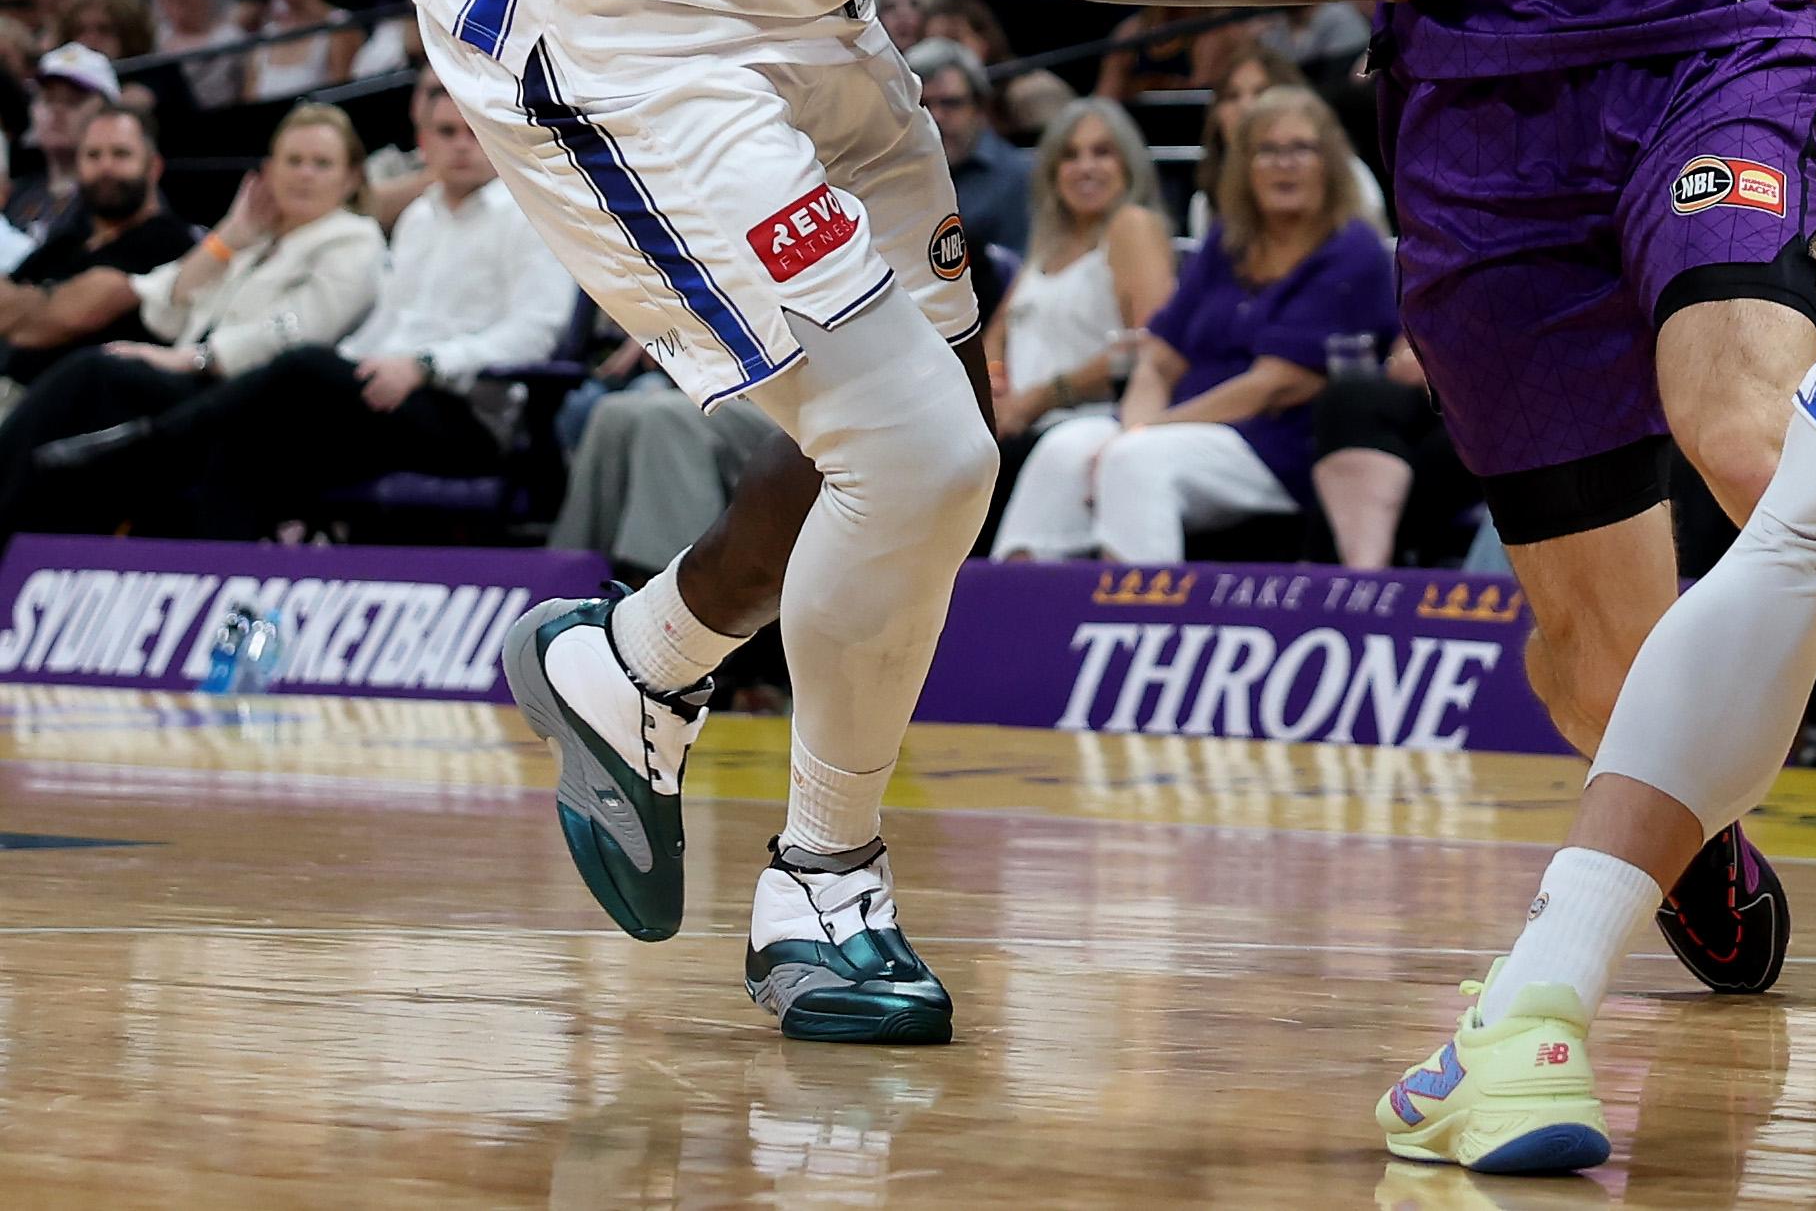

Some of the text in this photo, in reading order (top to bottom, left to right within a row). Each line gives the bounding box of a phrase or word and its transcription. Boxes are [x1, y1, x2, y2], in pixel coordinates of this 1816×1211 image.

[1681, 171, 1718, 200] NBL
[779, 219, 855, 271] FITNES
[940, 231, 963, 264] NBL
[1209, 573, 1406, 617] TAKE THE
[0, 568, 222, 678] SYDNEY
[1055, 622, 1502, 751] THRONE
